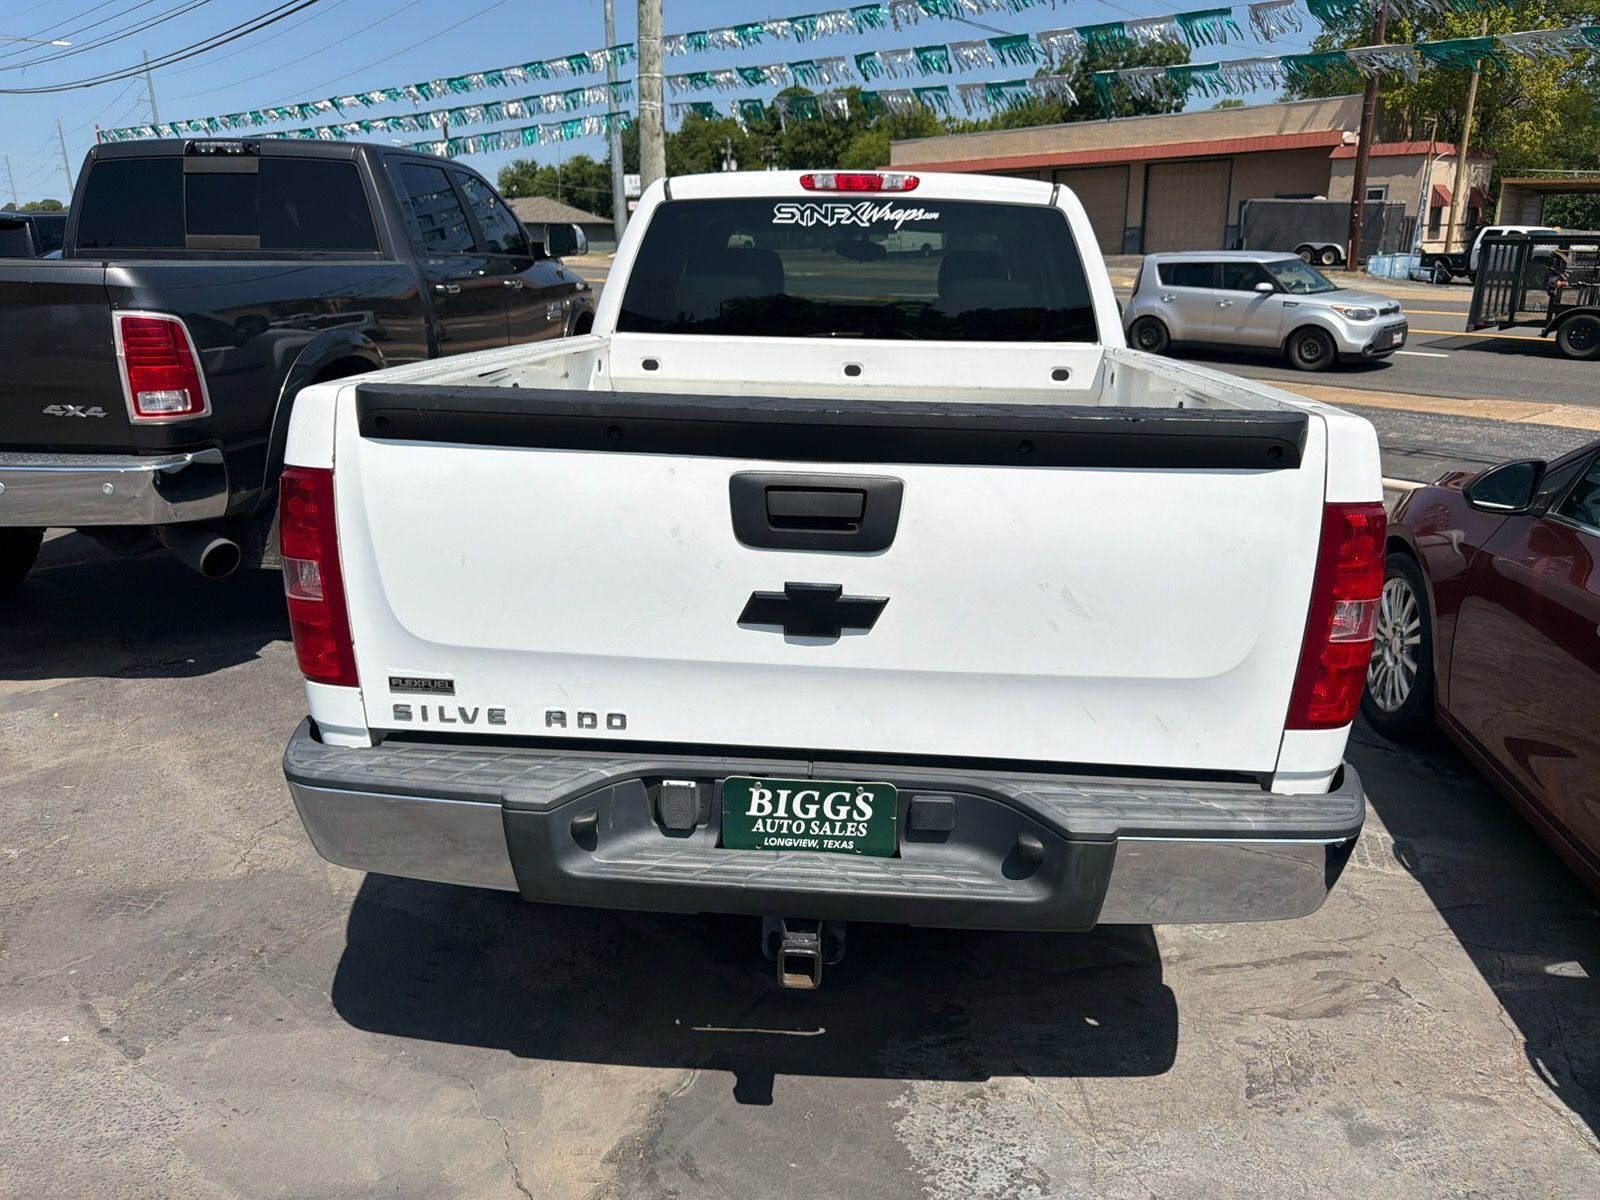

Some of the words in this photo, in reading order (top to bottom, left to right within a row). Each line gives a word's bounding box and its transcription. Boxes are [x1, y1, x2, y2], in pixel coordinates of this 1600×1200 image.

[391, 678, 452, 689] FLEXFUEL
[393, 704, 507, 726] SILVE
[546, 710, 627, 730] ADO
[745, 788, 875, 821] BIGGS
[752, 818, 806, 835] AUTO
[809, 820, 868, 837] SALES
[764, 836, 820, 849] LONGVIEW,
[823, 839, 854, 849] TEXAS
